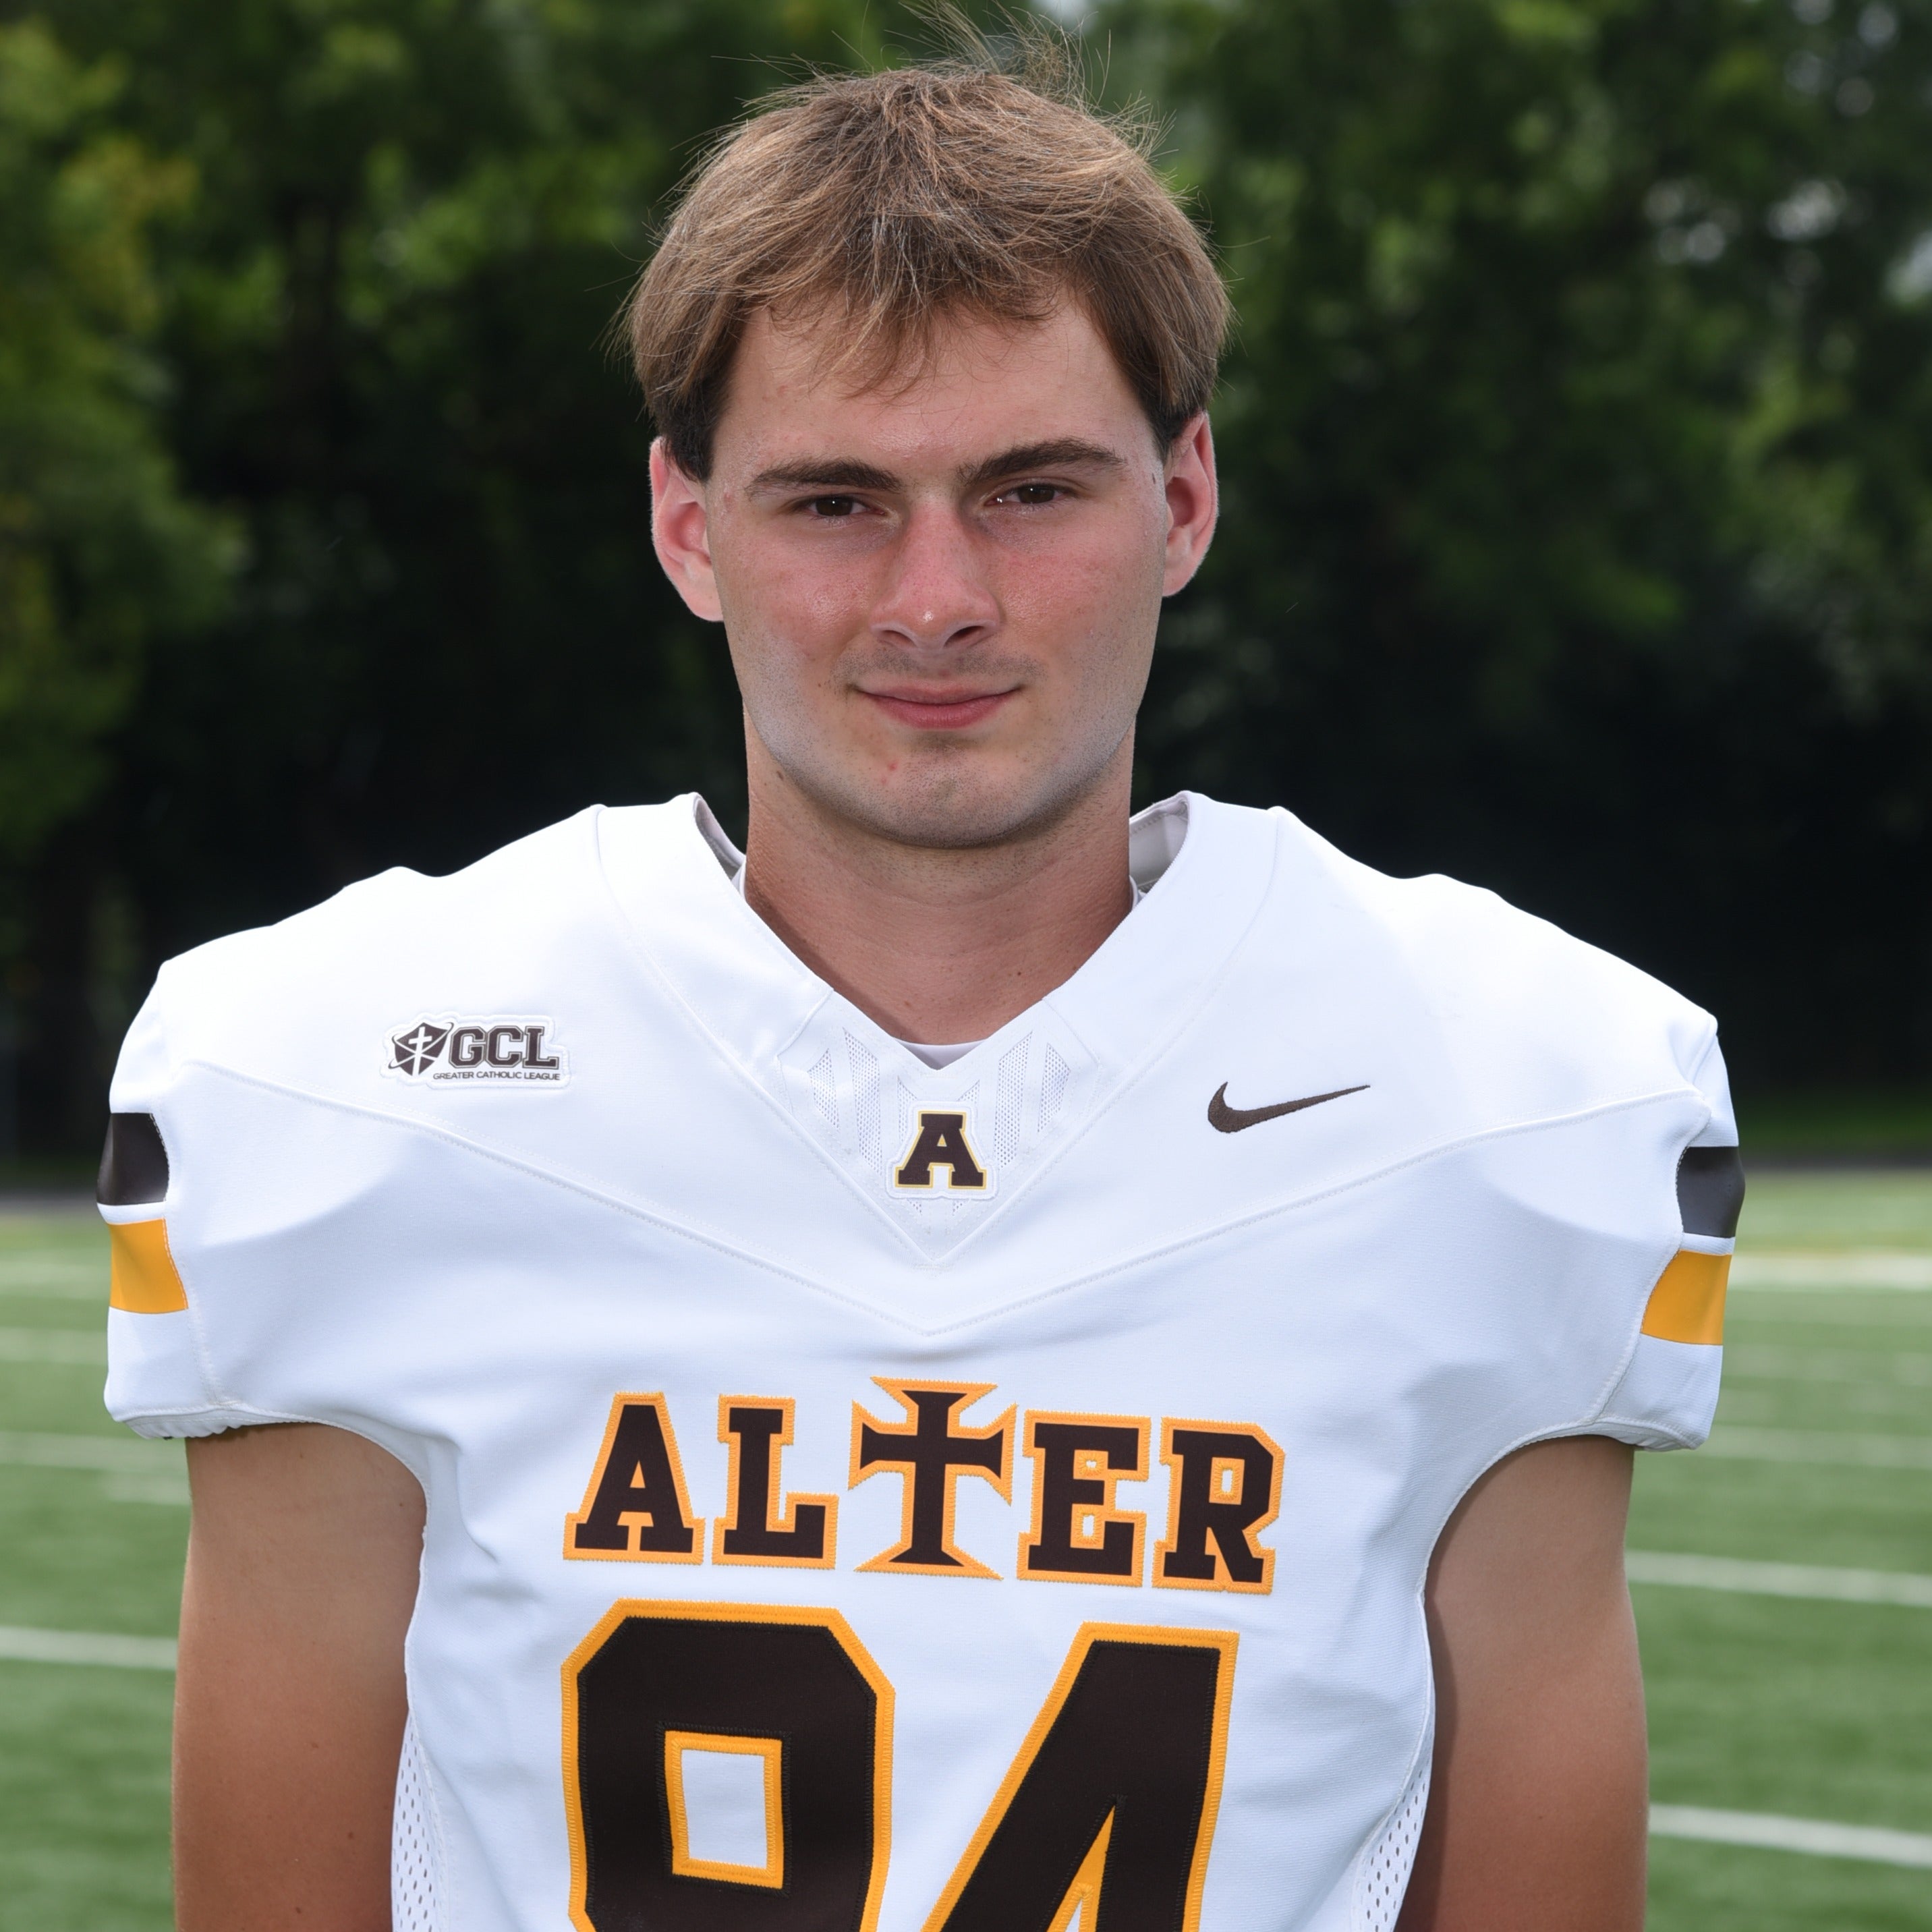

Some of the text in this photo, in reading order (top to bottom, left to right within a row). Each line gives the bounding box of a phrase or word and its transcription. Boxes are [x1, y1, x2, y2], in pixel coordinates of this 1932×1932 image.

[432, 1071, 561, 1081] GREATER CATHOLIC LEAGUE
[449, 1025, 560, 1070] GCL
[895, 1111, 988, 1189] A
[563, 1377, 1286, 1595] ALTER
